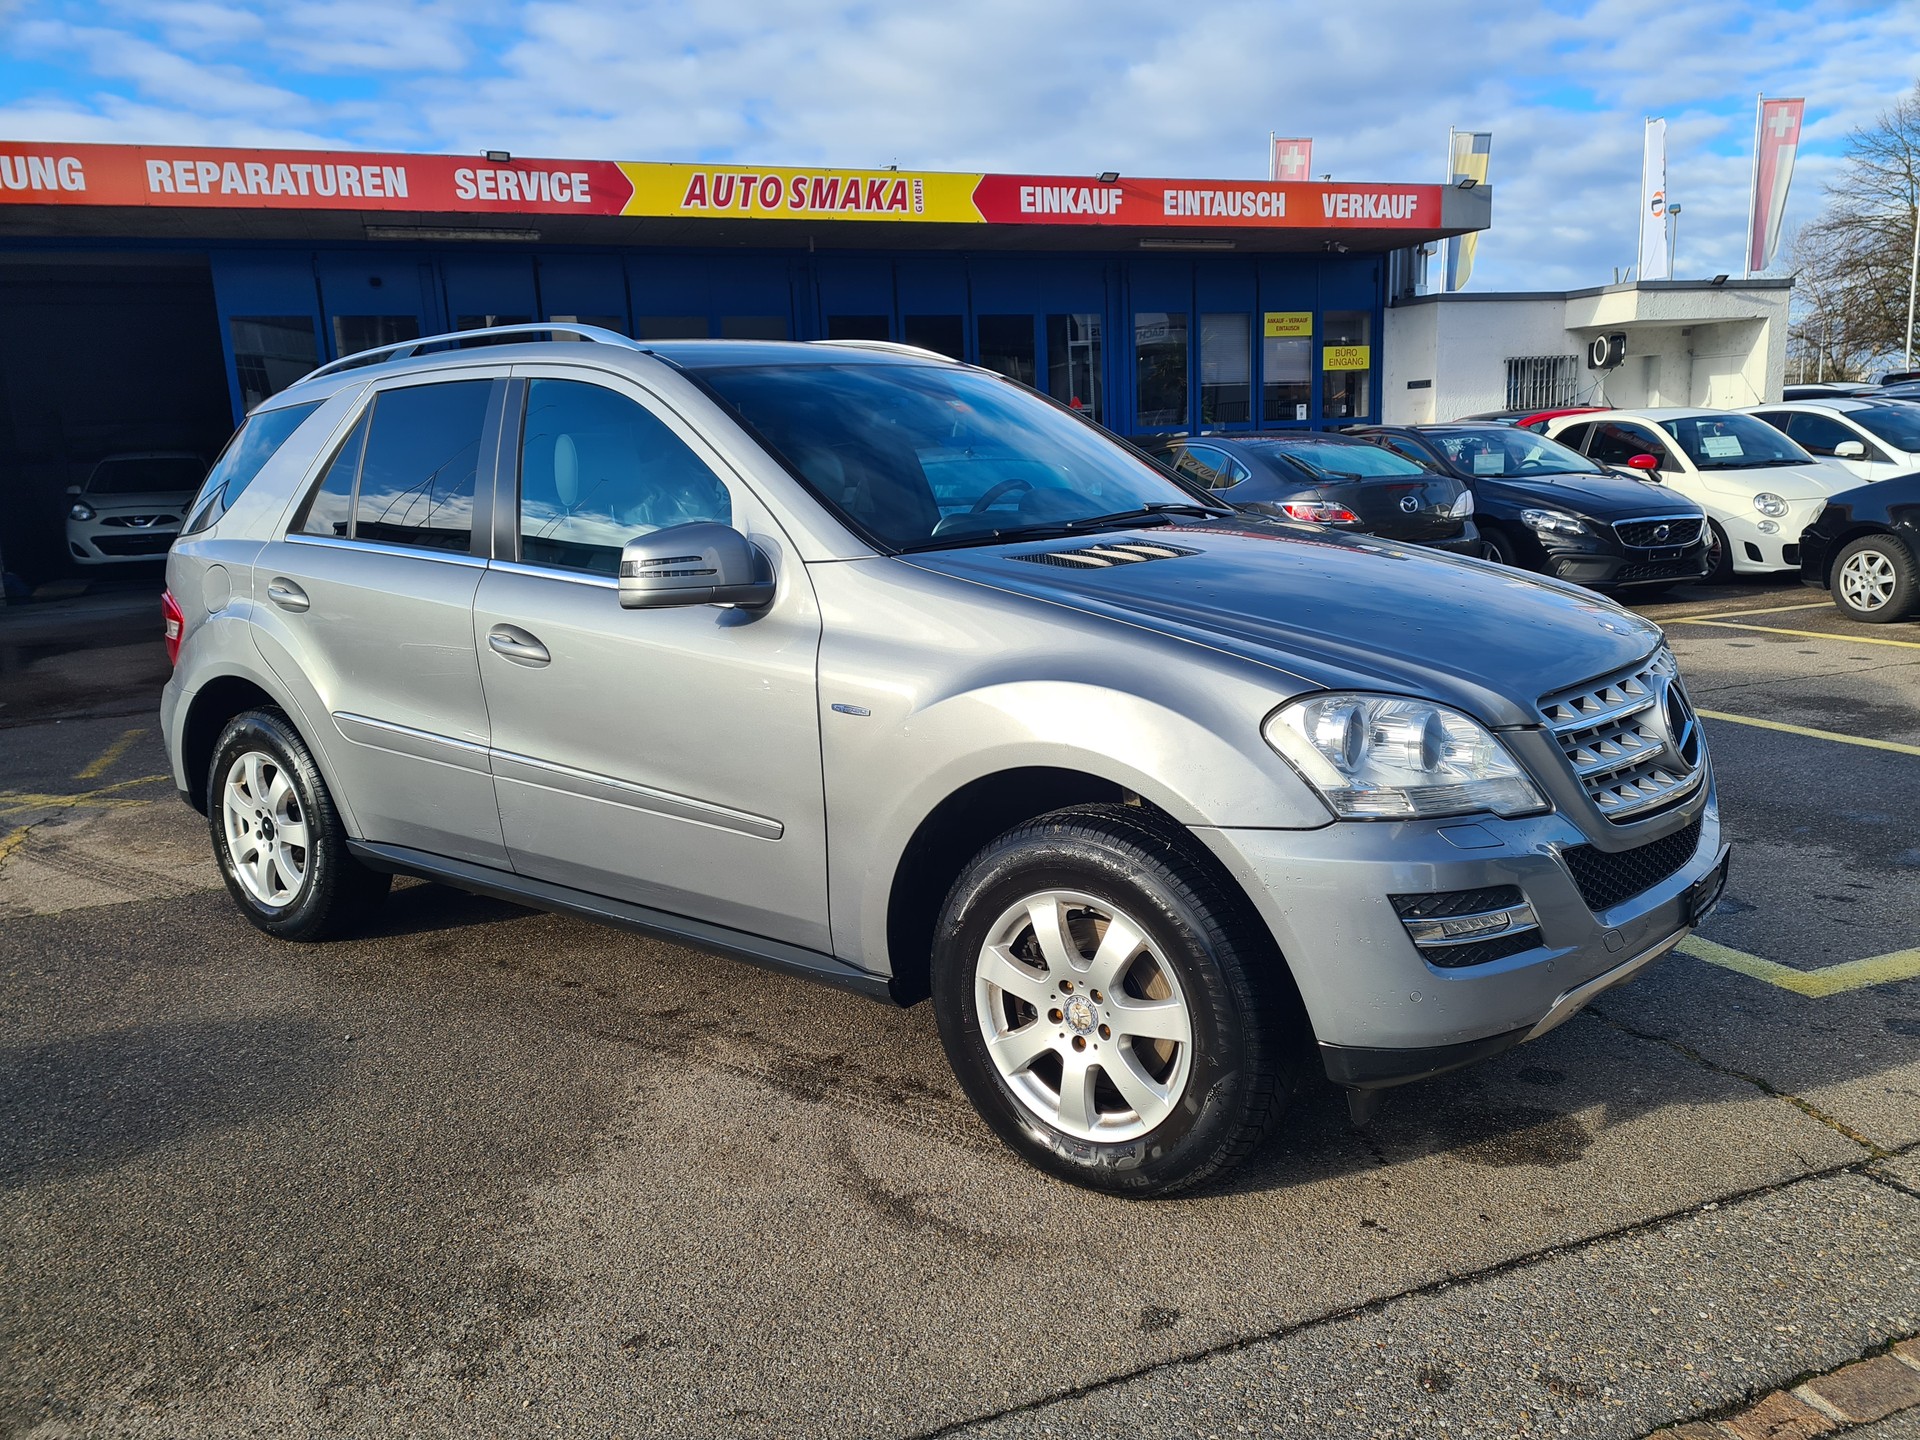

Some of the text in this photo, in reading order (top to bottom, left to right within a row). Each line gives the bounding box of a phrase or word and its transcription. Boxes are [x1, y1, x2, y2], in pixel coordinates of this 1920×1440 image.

[0, 155, 86, 191] UNG
[146, 160, 409, 198] REPARATUREN
[455, 168, 591, 203] SERVICE
[681, 172, 910, 213] AUTO SMAKA
[914, 179, 923, 213] GMBH
[1019, 186, 1123, 215] EINKAUF
[1163, 190, 1286, 218] EINTAUSCH
[1322, 193, 1418, 219] VERKAUF
[1328, 357, 1364, 366] EINGANG
[1335, 347, 1358, 357] BÜRO
